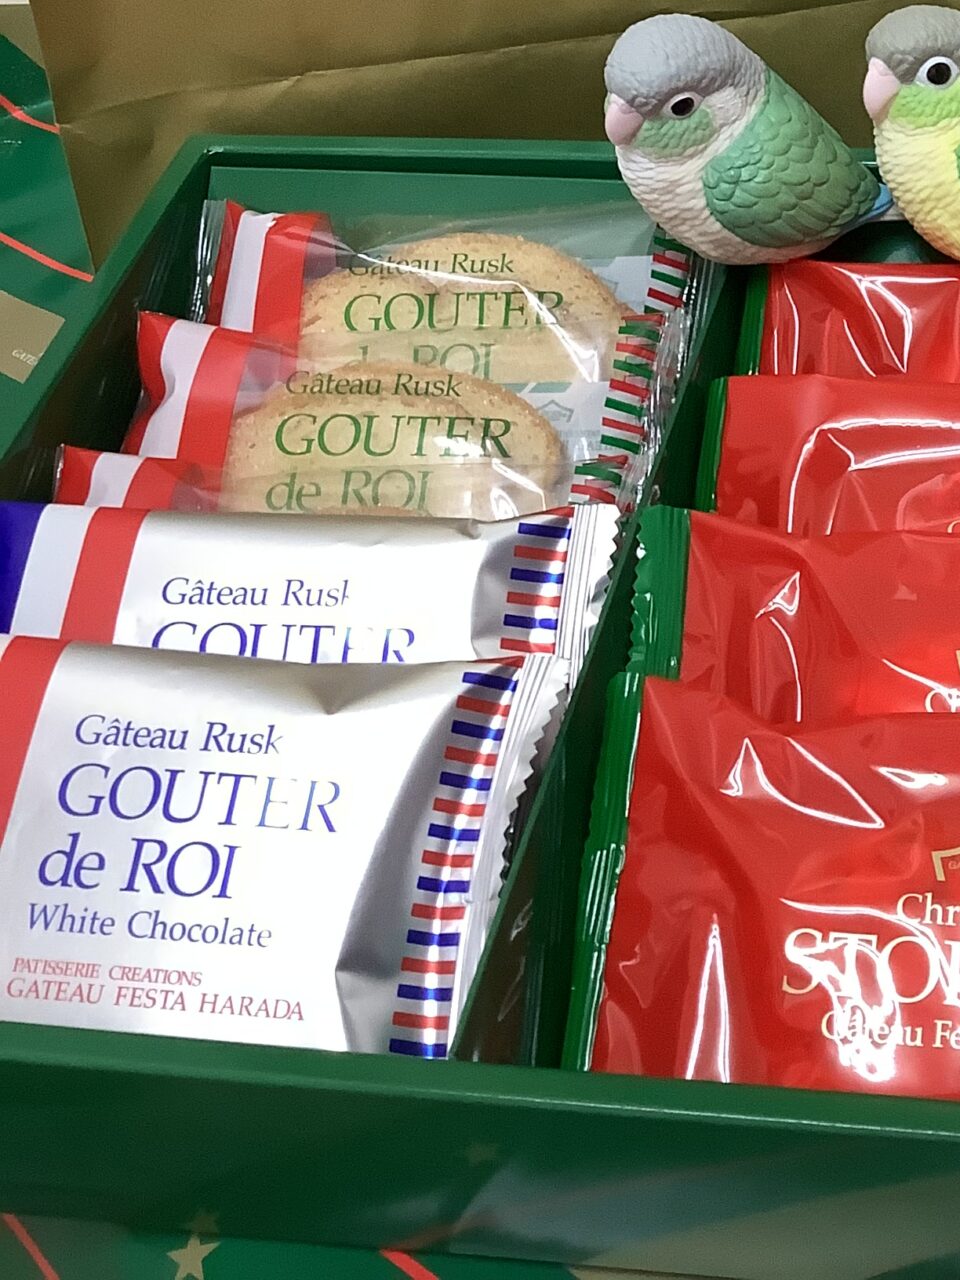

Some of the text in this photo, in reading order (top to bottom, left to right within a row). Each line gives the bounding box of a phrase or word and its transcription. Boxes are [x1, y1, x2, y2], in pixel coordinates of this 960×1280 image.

[450, 252, 515, 274] Rusk
[285, 370, 463, 398] Gâteau Rusk
[274, 412, 512, 459] GOUTER
[264, 469, 434, 513] de ROI
[161, 576, 269, 606] Gâteau
[75, 713, 284, 755] Gâteau Rusk
[57, 762, 341, 833] GOUTER
[37, 832, 242, 899] de ROI
[28, 902, 273, 949] White Chocolate
[12, 956, 203, 987] PATISSERIE CREATIONS
[6, 977, 305, 1021] GATEAU FESTA HARADA
